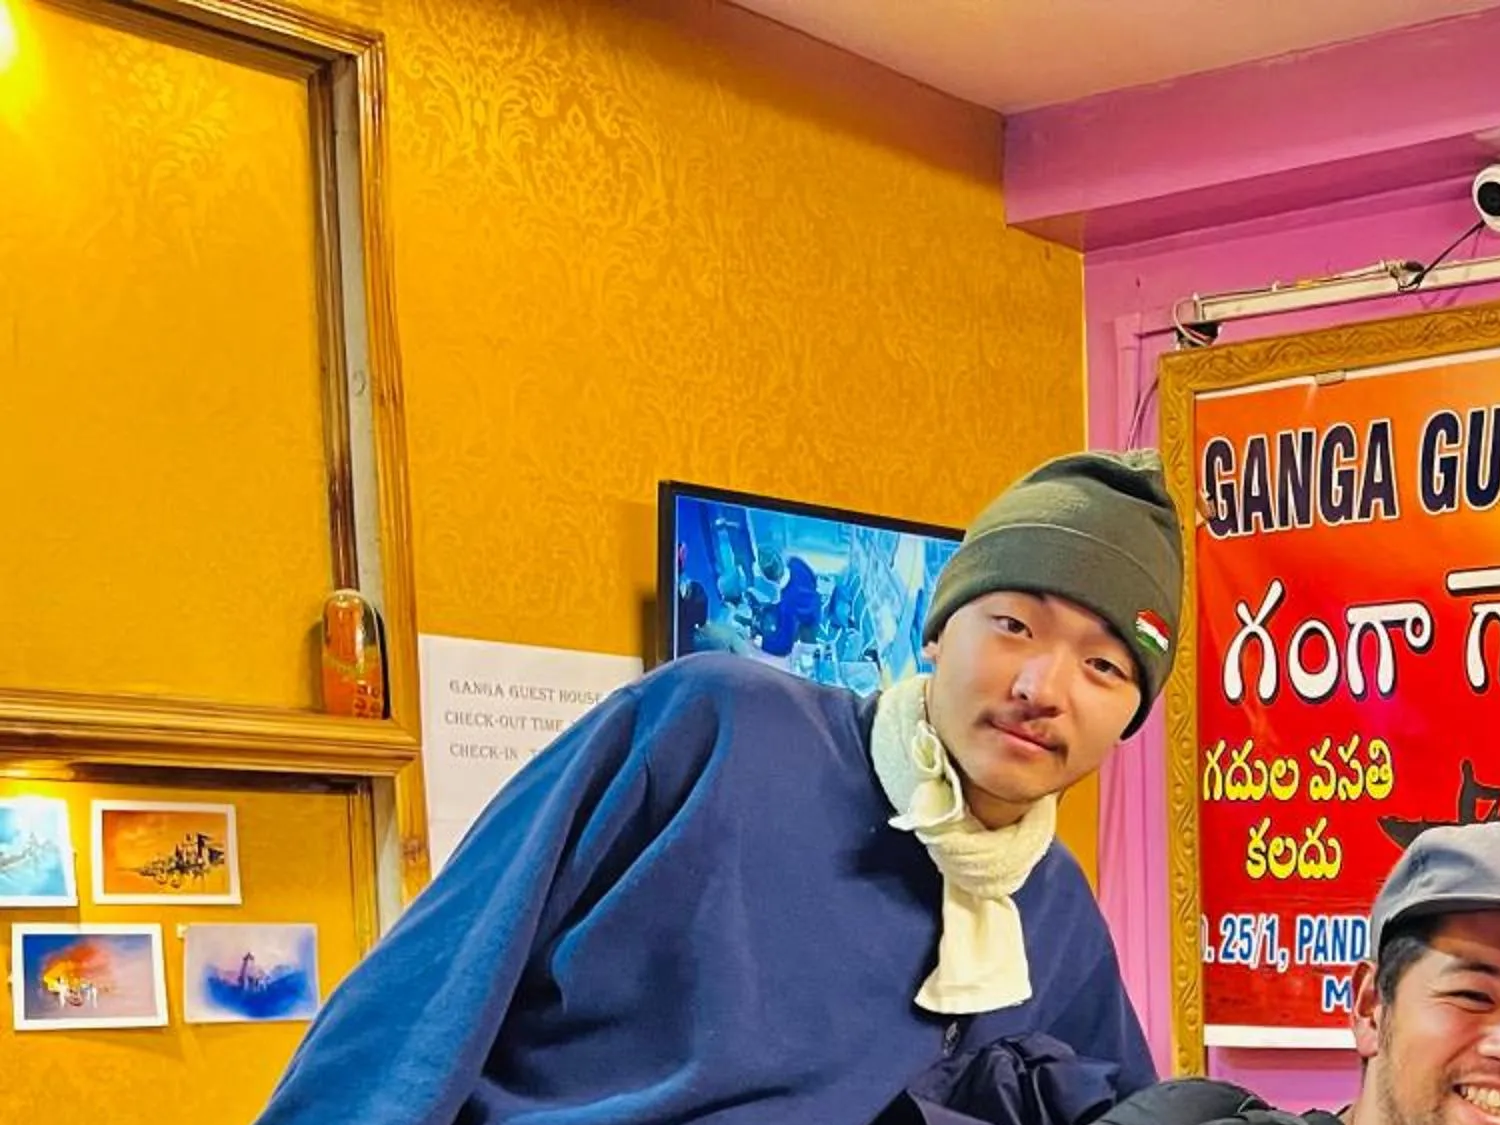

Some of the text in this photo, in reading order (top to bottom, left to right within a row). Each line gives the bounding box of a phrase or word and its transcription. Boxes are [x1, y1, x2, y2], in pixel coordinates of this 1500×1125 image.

[1203, 418, 1400, 540] GANGA
[1222, 578, 1434, 705] గంగా
[444, 710, 565, 733] CHECK-OUT TIME
[449, 680, 504, 699] GANGA
[508, 684, 555, 702] GUEST
[449, 743, 519, 761] CHECK-IN
[1203, 733, 1394, 801] గదుల వసతి
[1246, 816, 1342, 880] కలదు
[1218, 912, 1289, 973] 25/1,
[1295, 914, 1371, 966] PAND
